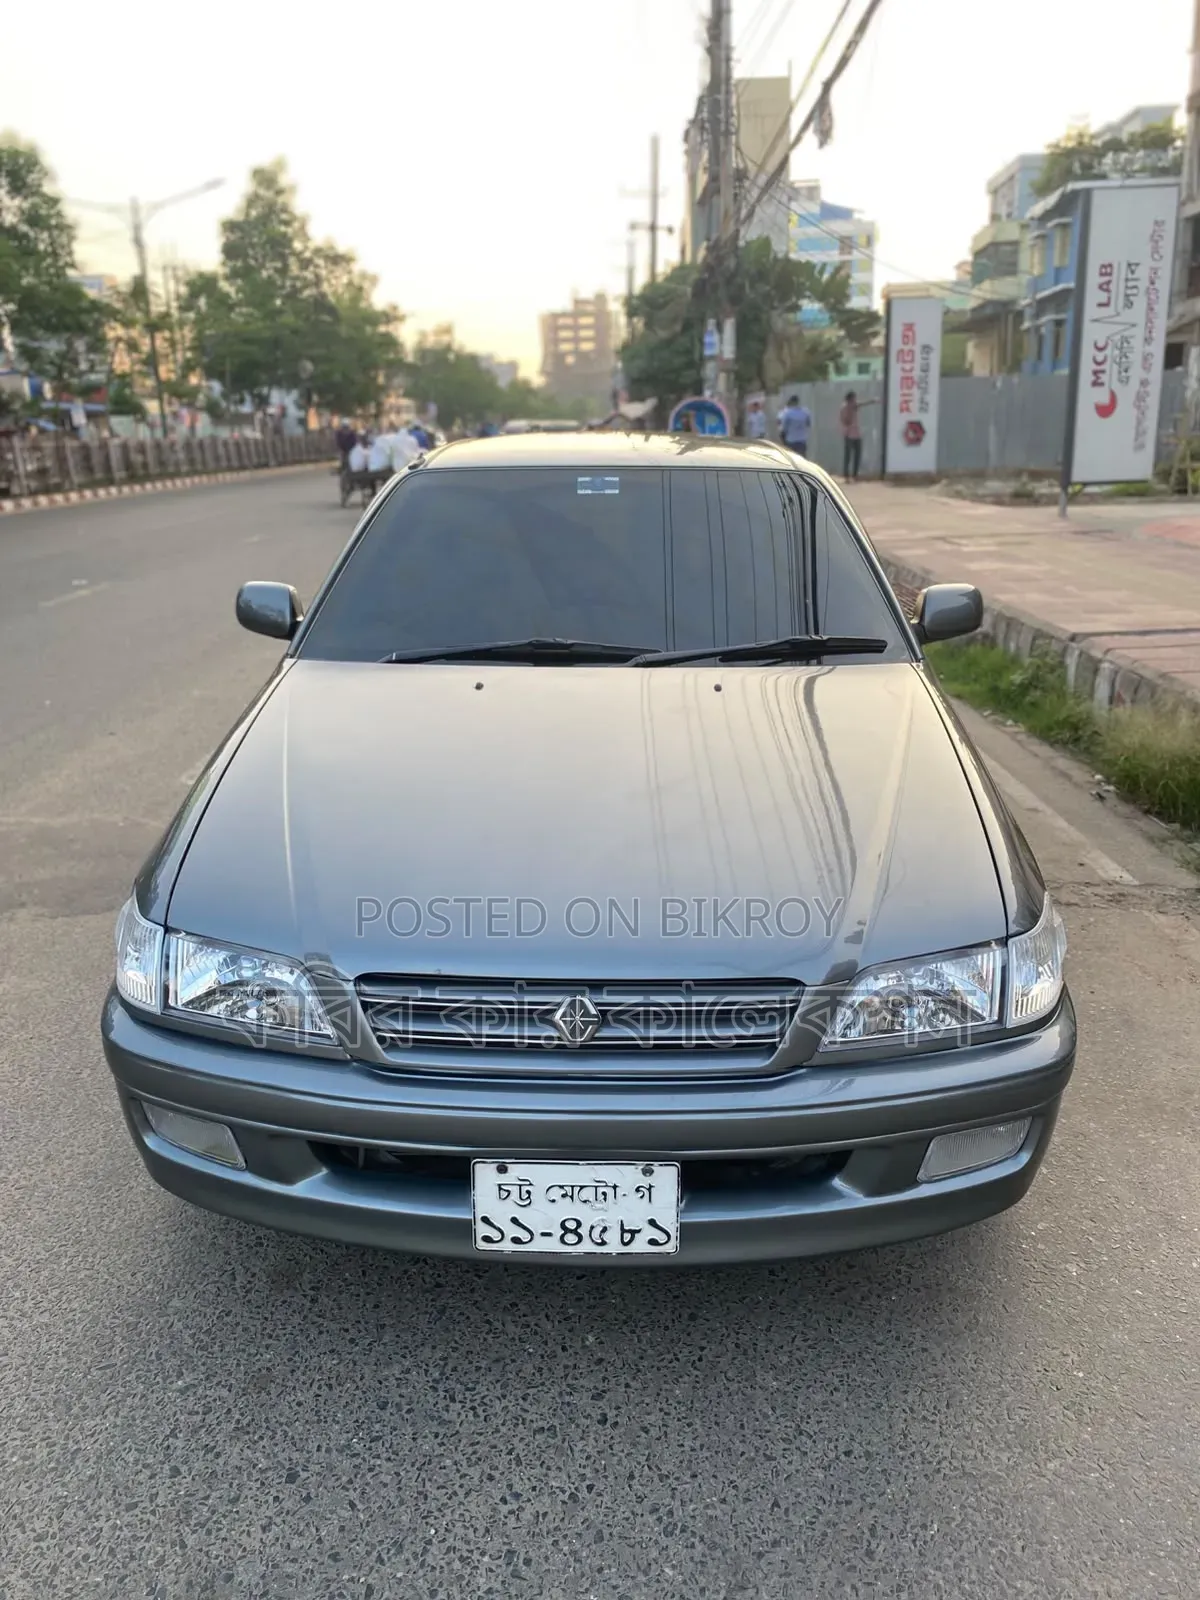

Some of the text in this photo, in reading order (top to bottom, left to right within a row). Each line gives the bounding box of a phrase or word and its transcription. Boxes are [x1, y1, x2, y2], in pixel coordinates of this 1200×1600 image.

[1090, 261, 1114, 387] MCC LAB
[1114, 260, 1141, 386] এমসিসি ল্যাব
